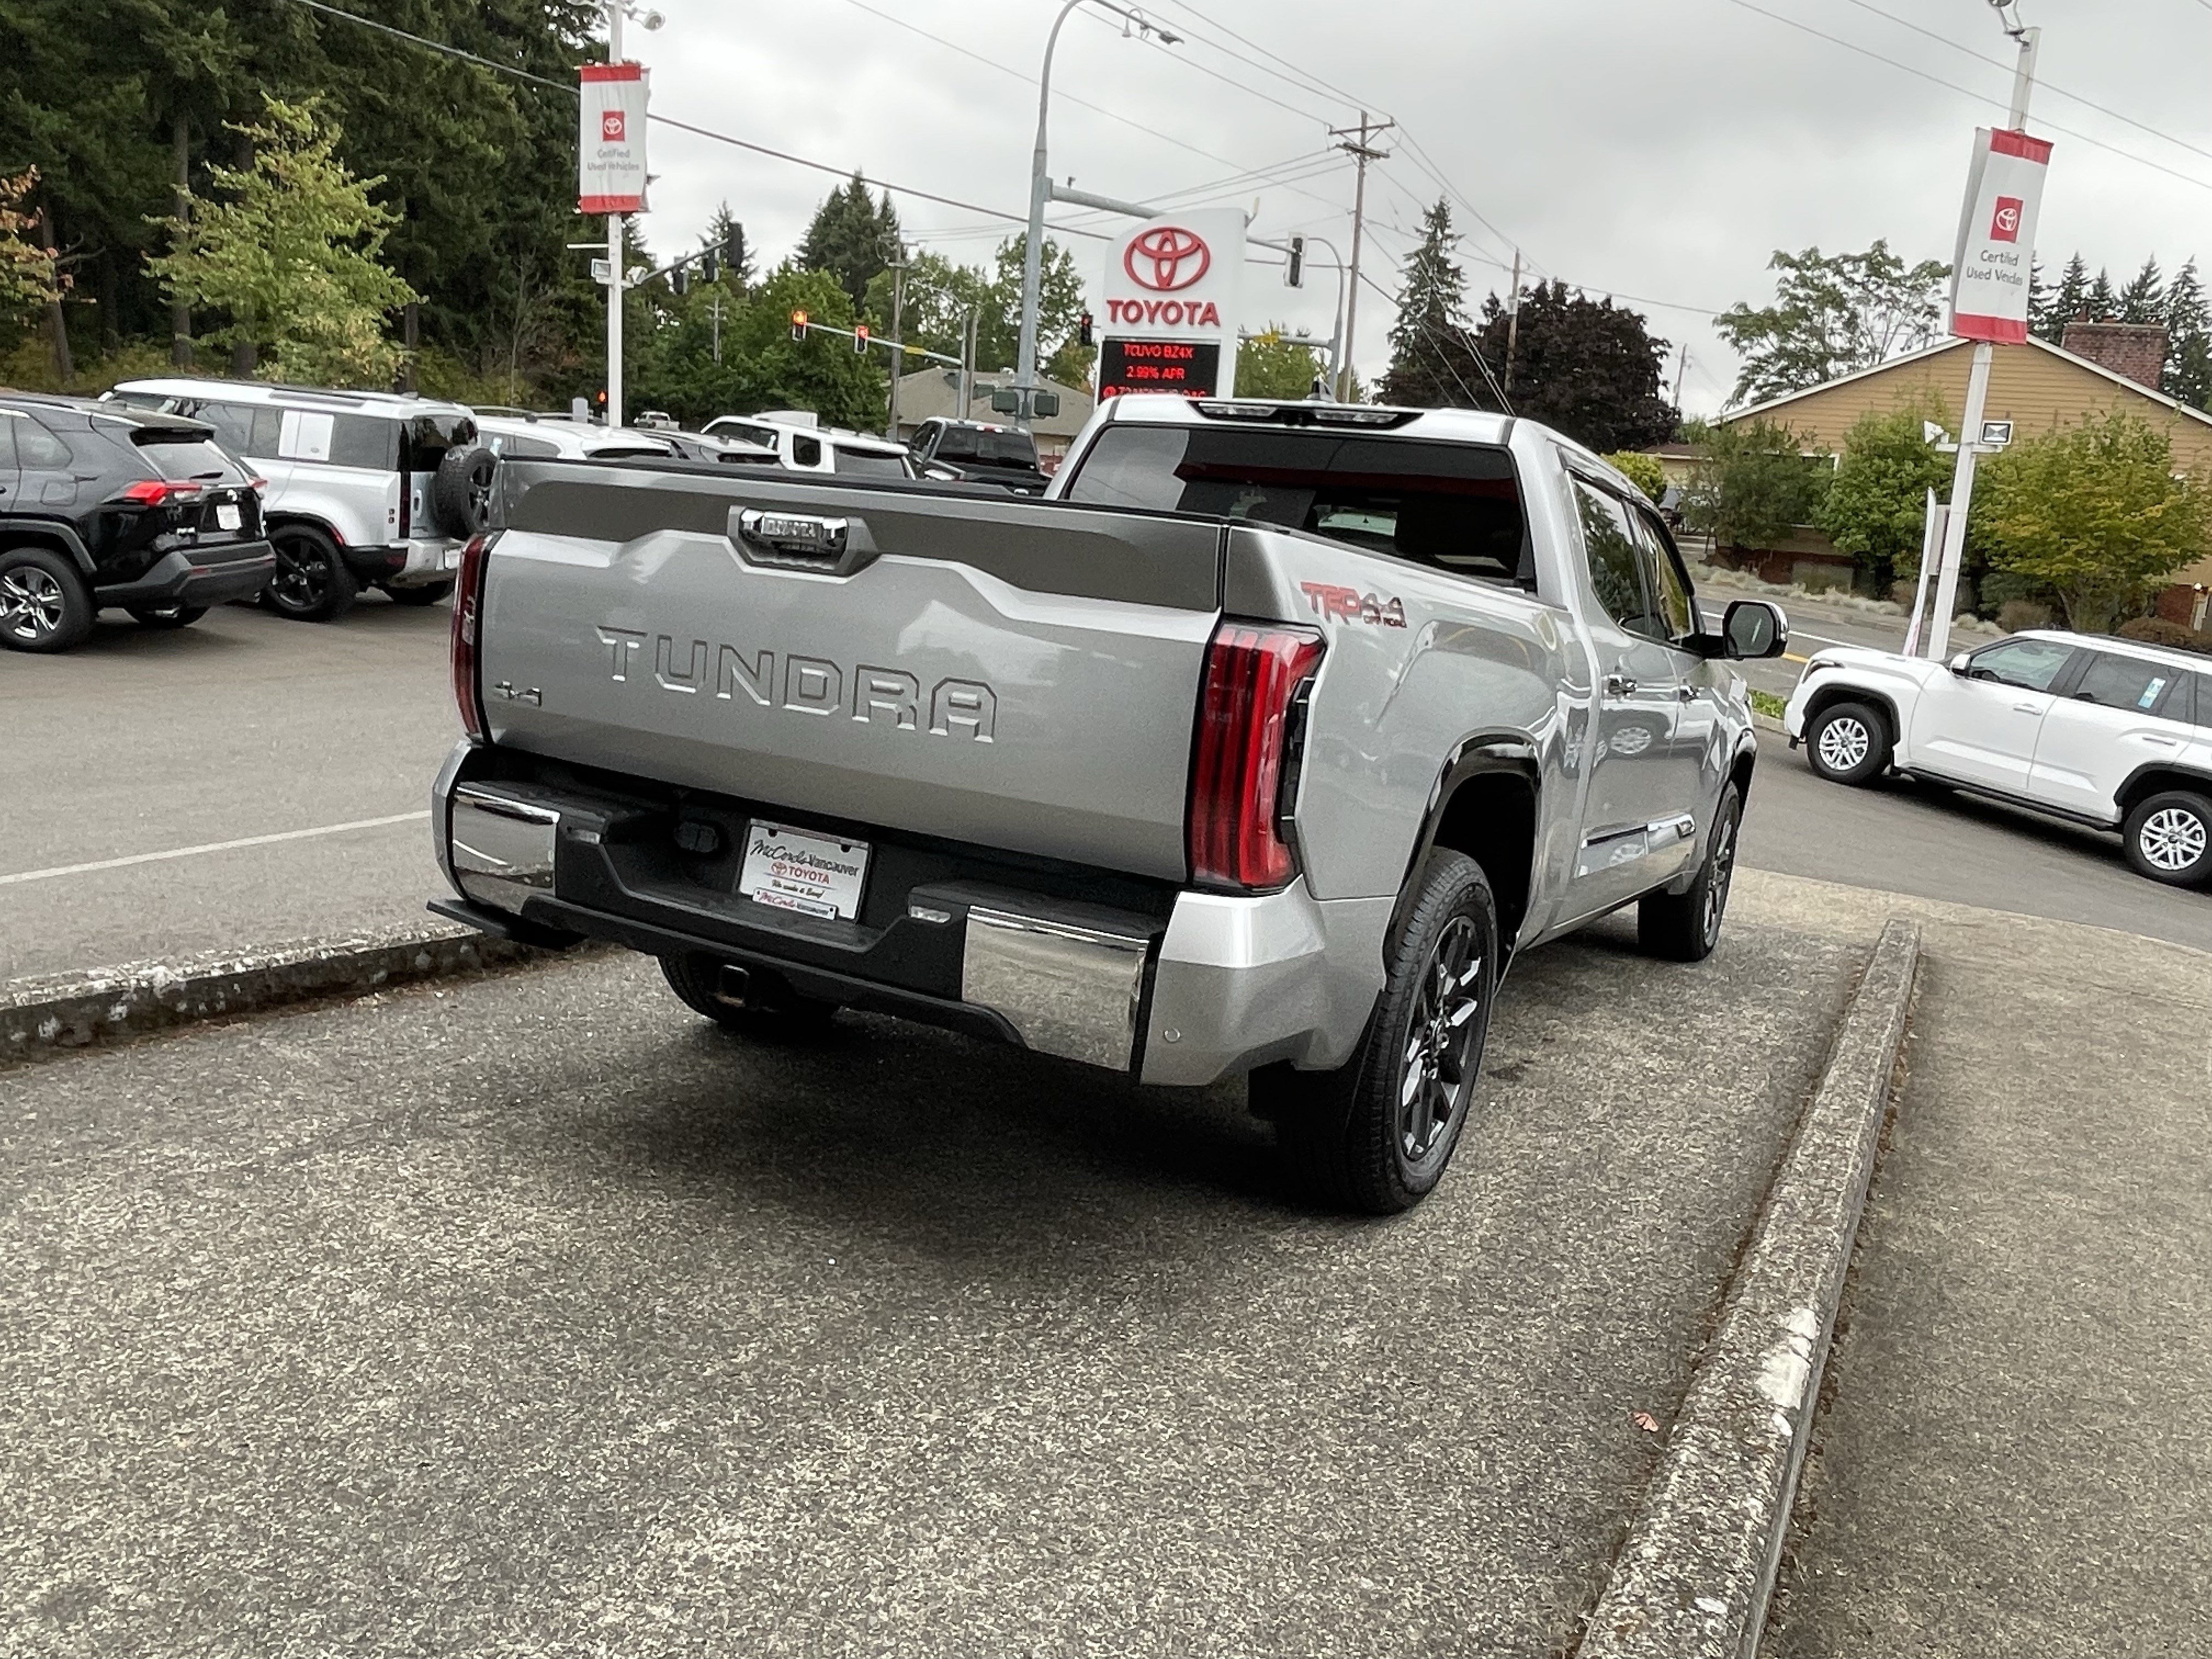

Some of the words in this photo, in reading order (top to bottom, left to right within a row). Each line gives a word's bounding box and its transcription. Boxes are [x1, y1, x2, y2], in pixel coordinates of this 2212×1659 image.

[1967, 266, 1992, 280] Used
[1107, 300, 1220, 326] TOYOTA
[1162, 368, 1185, 381] APR
[596, 625, 998, 744] TUNDRA
[788, 866, 830, 884] TOYOTA
